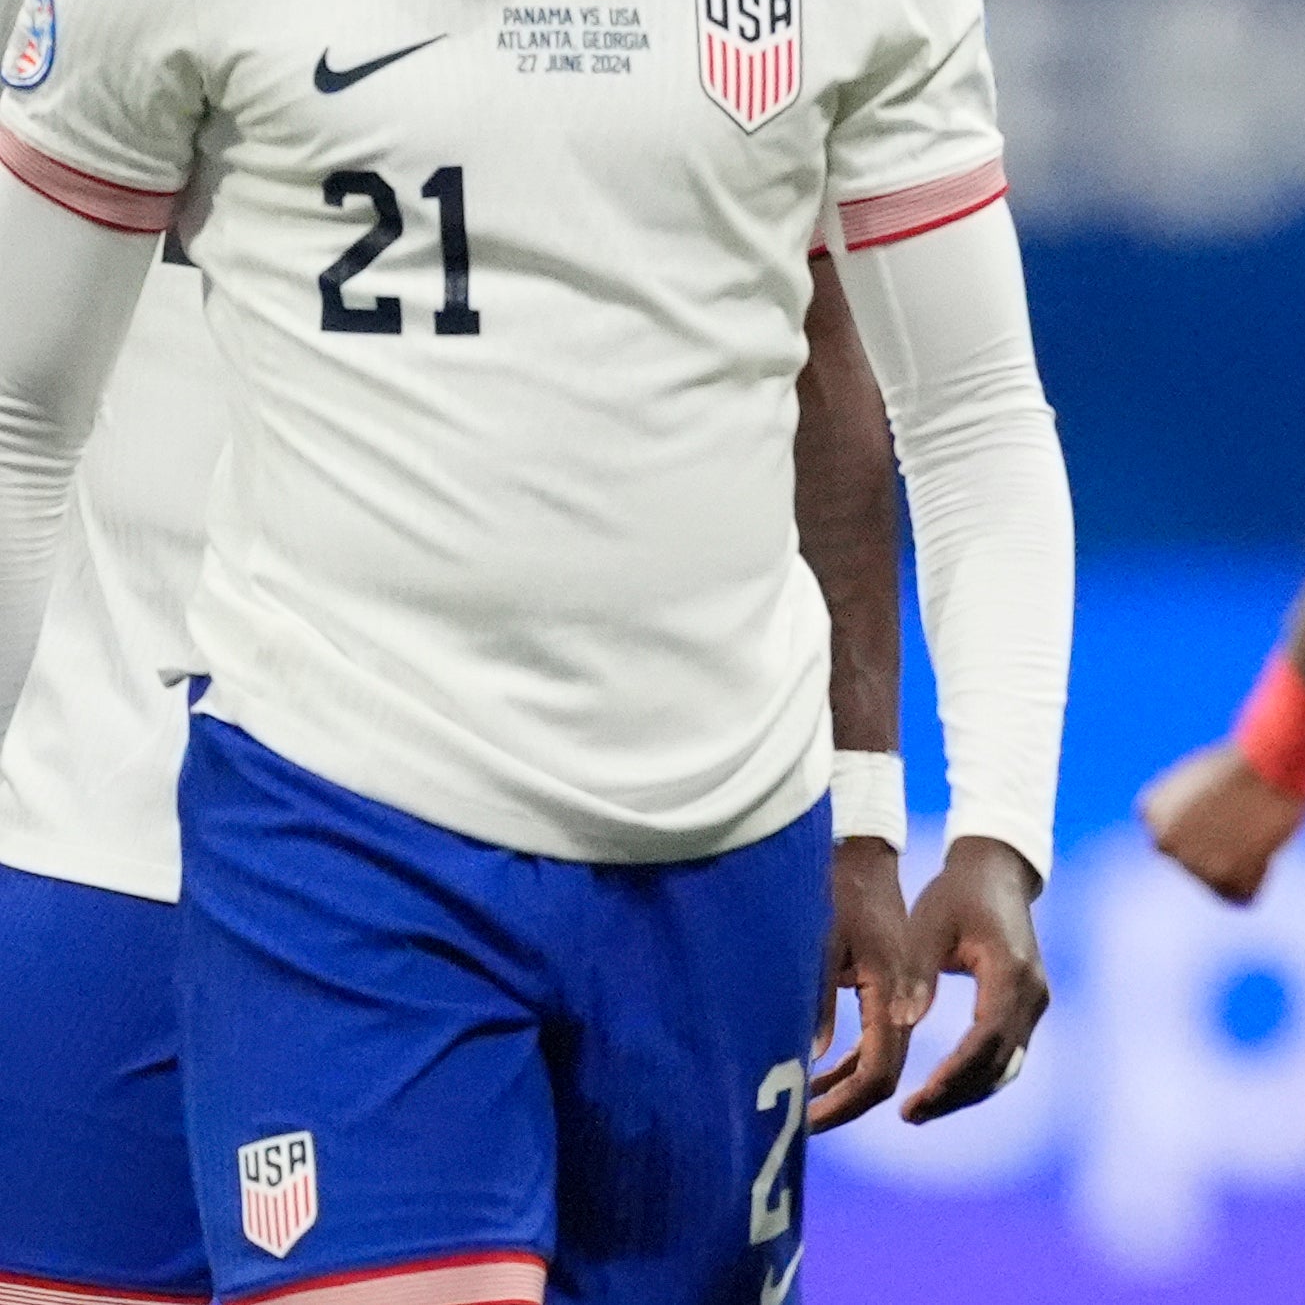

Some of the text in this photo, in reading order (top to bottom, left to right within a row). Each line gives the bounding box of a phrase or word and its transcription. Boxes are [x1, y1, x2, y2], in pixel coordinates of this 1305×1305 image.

[502, 7, 573, 26] PANAMA
[609, 7, 641, 27] USA
[582, 31, 650, 50] GEORGIA
[517, 54, 631, 74] 27 JUNE 2024
[319, 166, 480, 335] 21
[245, 1139, 306, 1187] USA
